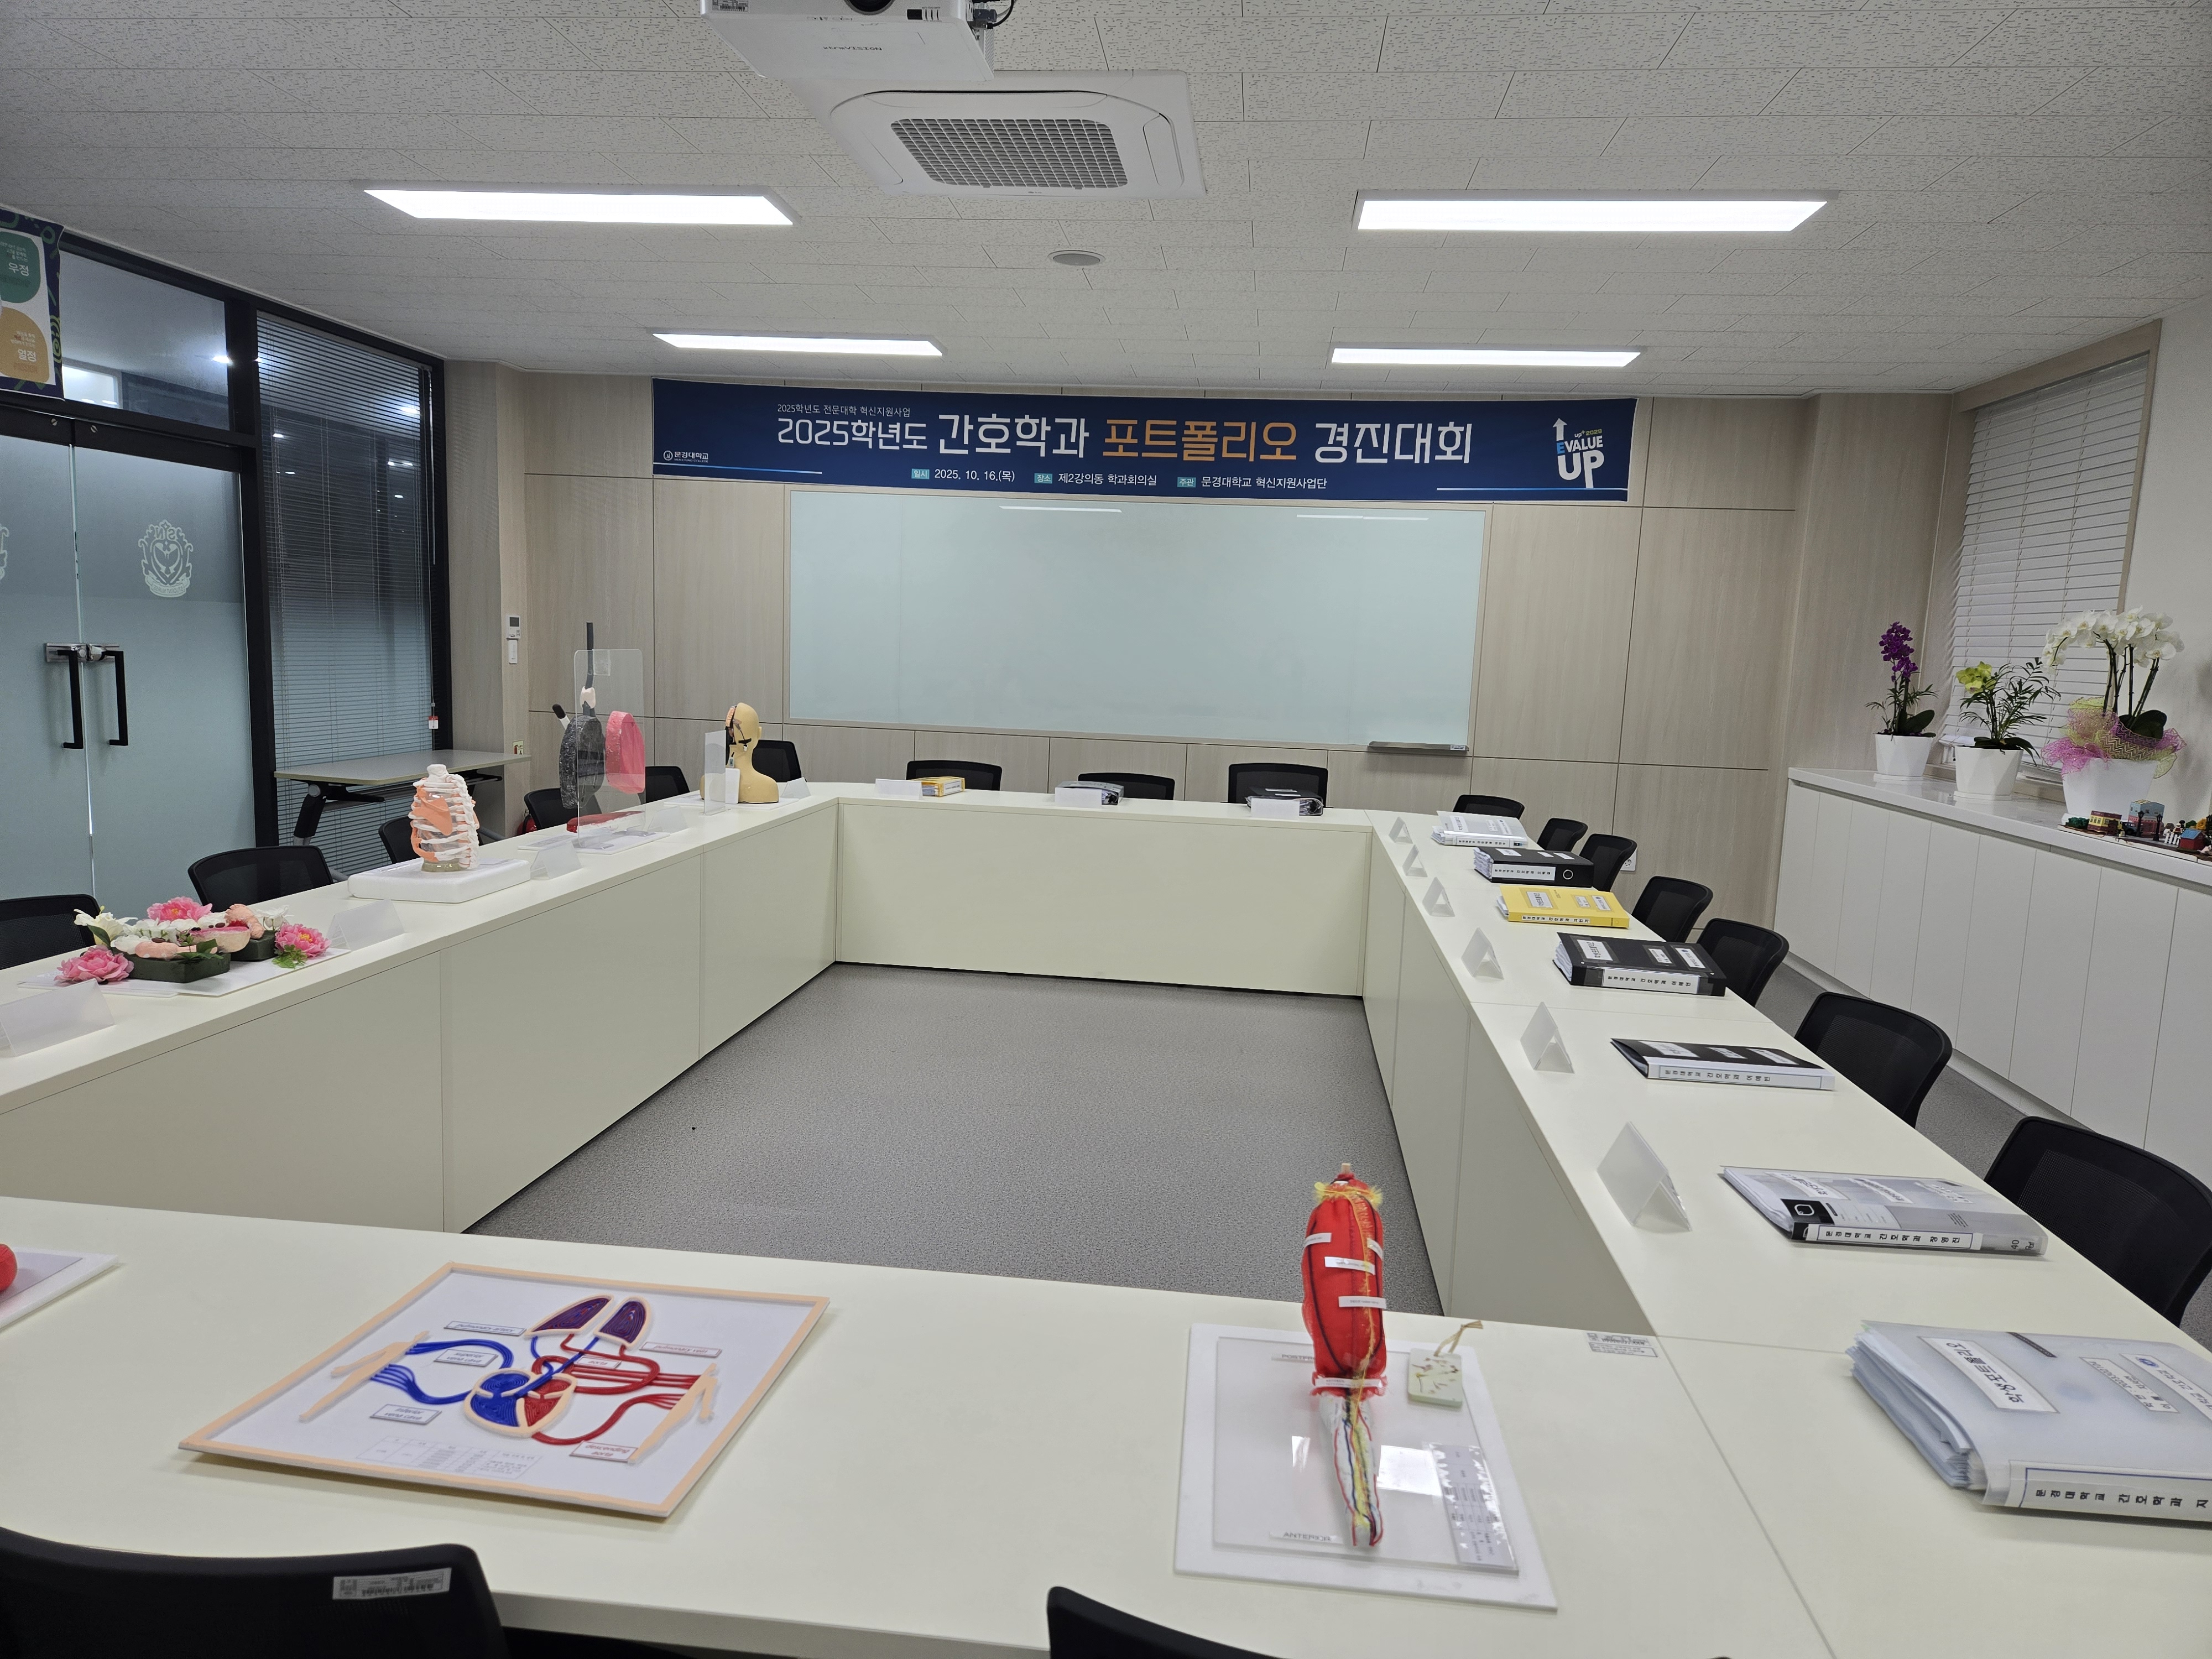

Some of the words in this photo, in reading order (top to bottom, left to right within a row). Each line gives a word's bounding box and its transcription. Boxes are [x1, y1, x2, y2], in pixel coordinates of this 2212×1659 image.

[9, 262, 29, 276] 우정
[777, 404, 821, 414] 2025학년도
[823, 405, 857, 416] 전문대학
[859, 406, 911, 418] 혁신지원사업
[778, 418, 927, 450] 2025학년도
[938, 413, 1089, 458] 간호학과
[1102, 418, 1297, 462] 포트폴리오
[1314, 421, 1473, 464] 경진대회
[1556, 435, 1603, 454] EVALUE
[674, 451, 709, 460] 문경대학교
[914, 470, 928, 478] 일시
[934, 468, 962, 480] 2025.
[966, 470, 980, 481] 10.
[984, 470, 1015, 482] 16.(목)
[1557, 450, 1604, 489] UP
[1037, 474, 1051, 483] 장소
[1058, 472, 1104, 484] 제2강의동
[1107, 473, 1157, 486] 학과회의실
[1179, 478, 1194, 487] 주관
[1201, 476, 1252, 488] 문경대학교
[1255, 477, 1328, 489] 혁신지원사업단
[1825, 1230, 1872, 1239] 문경대학교
[1879, 1233, 1922, 1243] 간호학과
[2011, 1239, 2020, 1250] 40
[1945, 1342, 2025, 1404] 학생포트폴리오
[585, 1443, 630, 1454] descending
[2035, 1489, 2105, 1501] 문경대학교
[2118, 1493, 2183, 1507] 간호학과
[2196, 1499, 2209, 1509] 지
